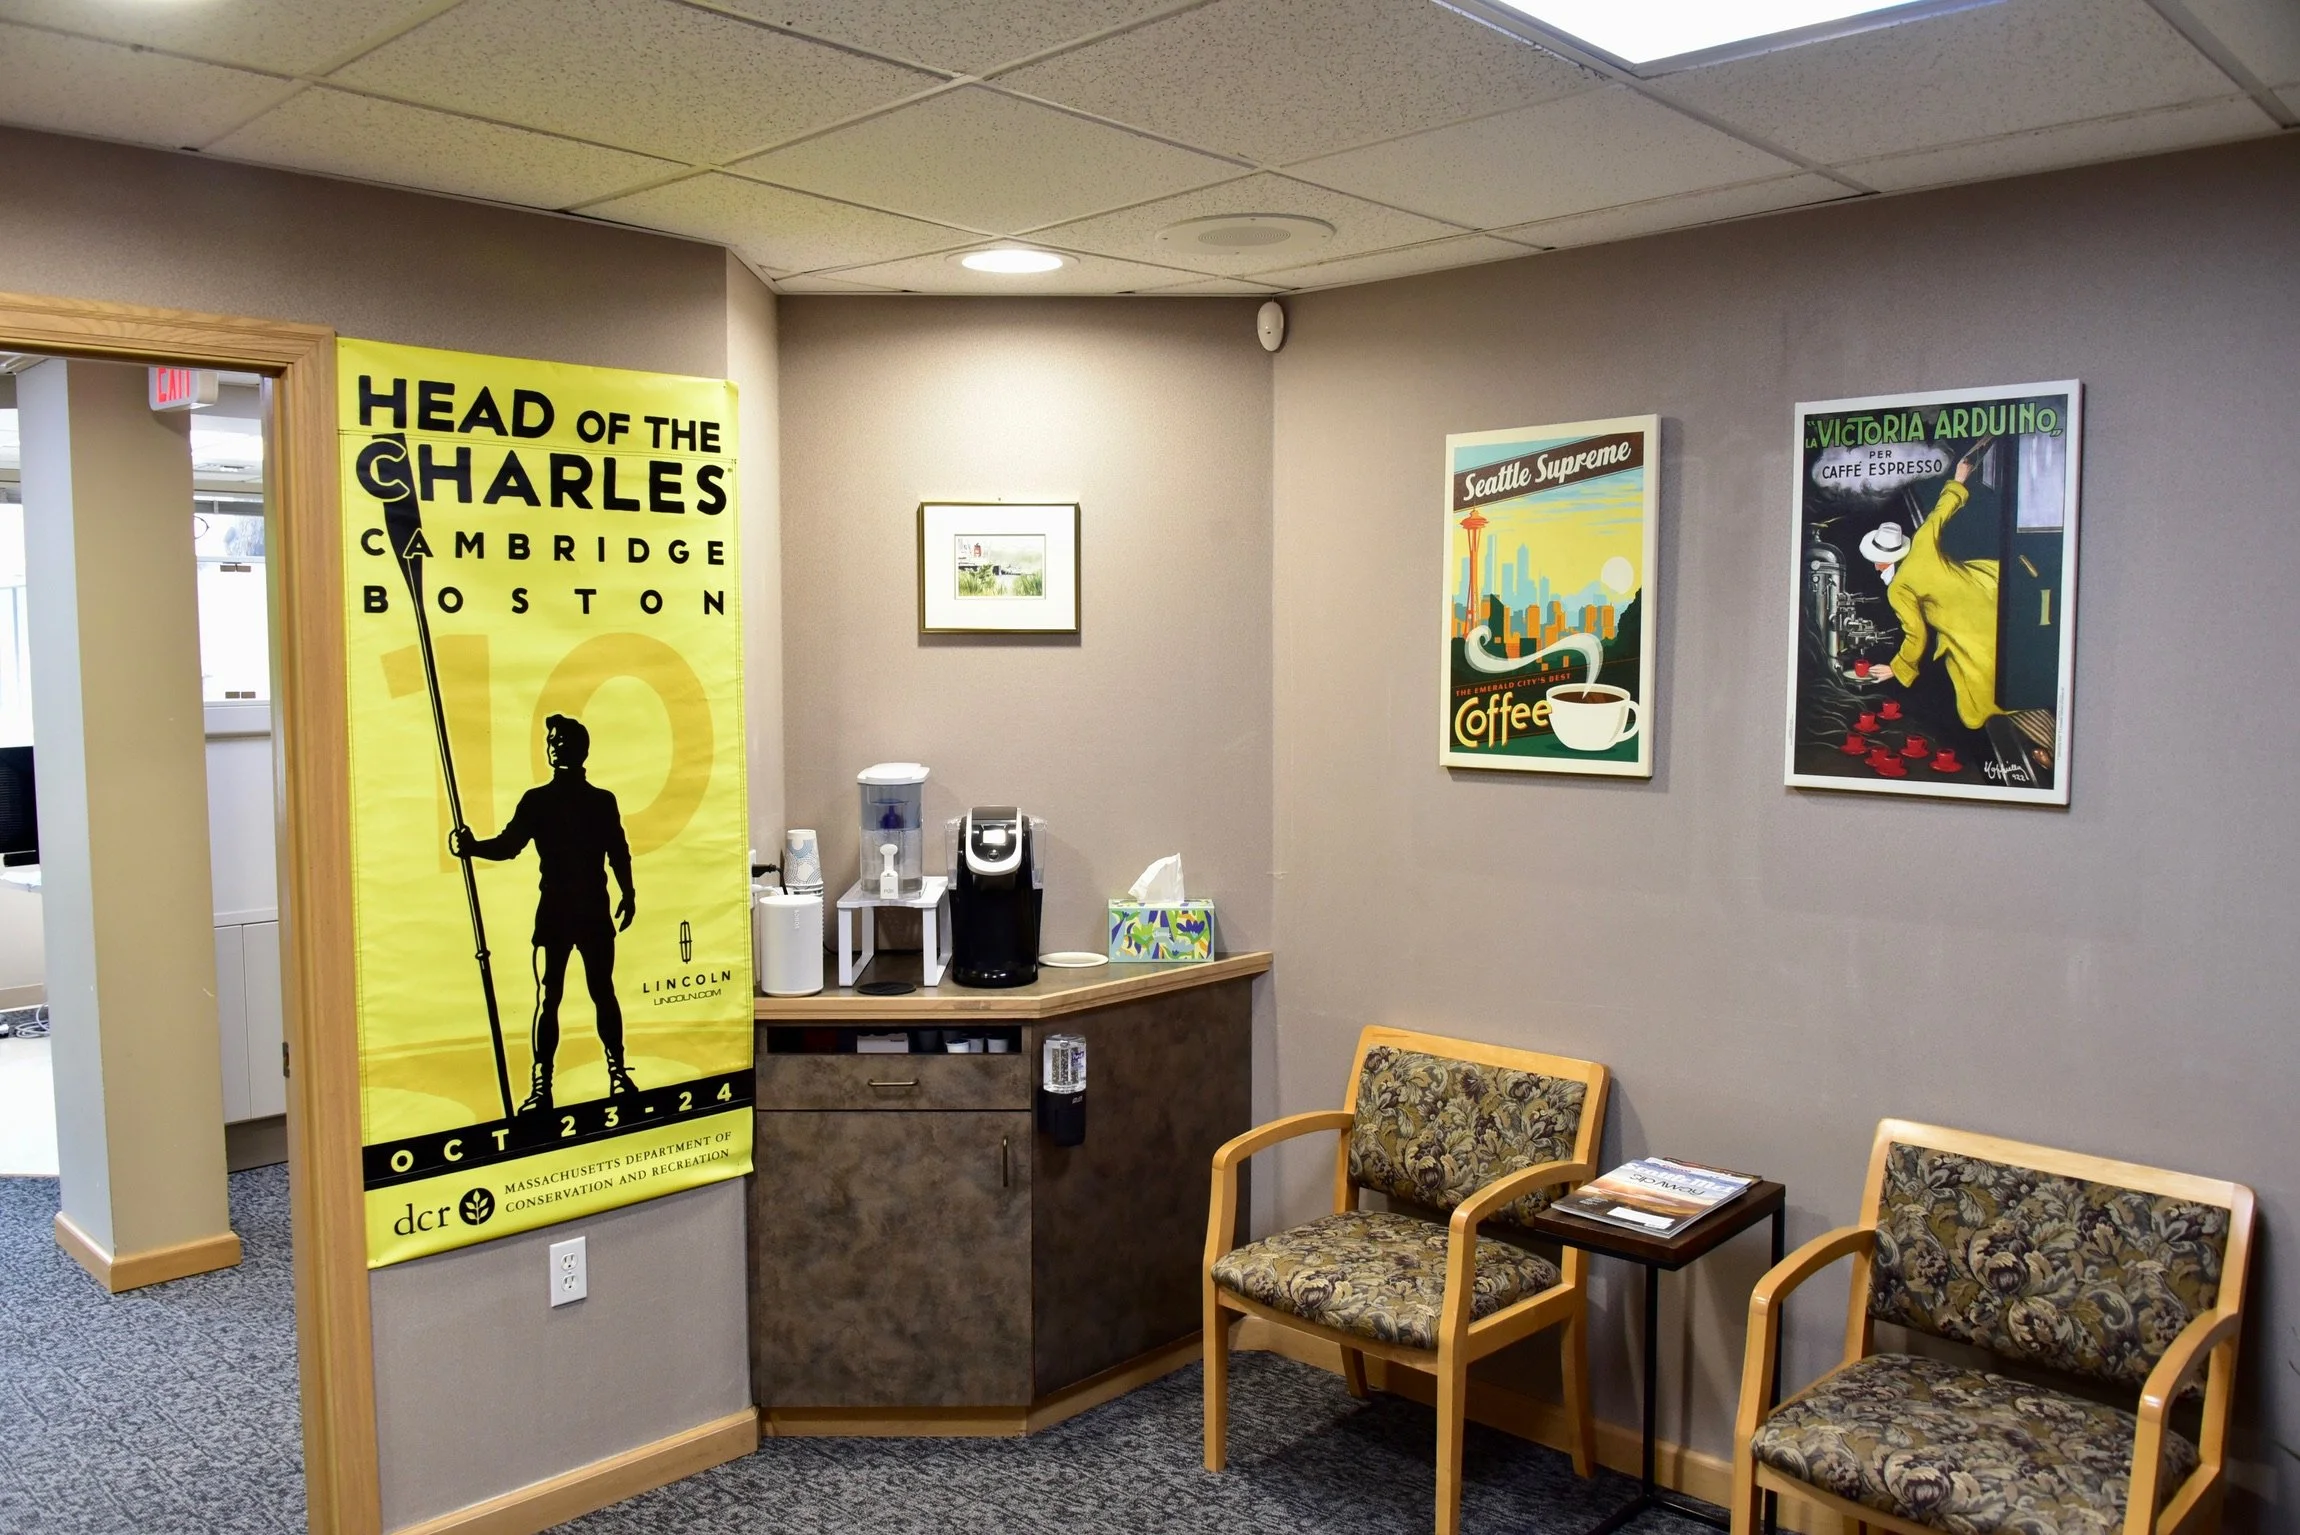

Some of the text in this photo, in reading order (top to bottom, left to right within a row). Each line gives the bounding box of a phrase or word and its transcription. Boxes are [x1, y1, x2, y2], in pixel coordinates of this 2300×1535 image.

[358, 375, 722, 453] HEAD OF THE
[1463, 441, 1631, 501] Seattle Supreme
[1869, 450, 1892, 459] PER
[1869, 459, 1943, 476] ESPRESSO
[356, 439, 727, 516] CHARLES
[361, 528, 725, 566] CAMBRIDGE
[364, 586, 724, 616] BOSTON
[1456, 673, 1571, 697] THE EMERALD CITY'S BEST
[1455, 691, 1553, 748] Coffee
[643, 970, 731, 993] LINCOLN
[654, 988, 721, 1006] LINCOLN.COM
[390, 1129, 510, 1173] OCT
[504, 1131, 732, 1195] MASSACHUSETTS DEPARTMENT OF
[505, 1149, 730, 1213] CONSERVATION AND RECREATION
[394, 1203, 451, 1237] dcr
